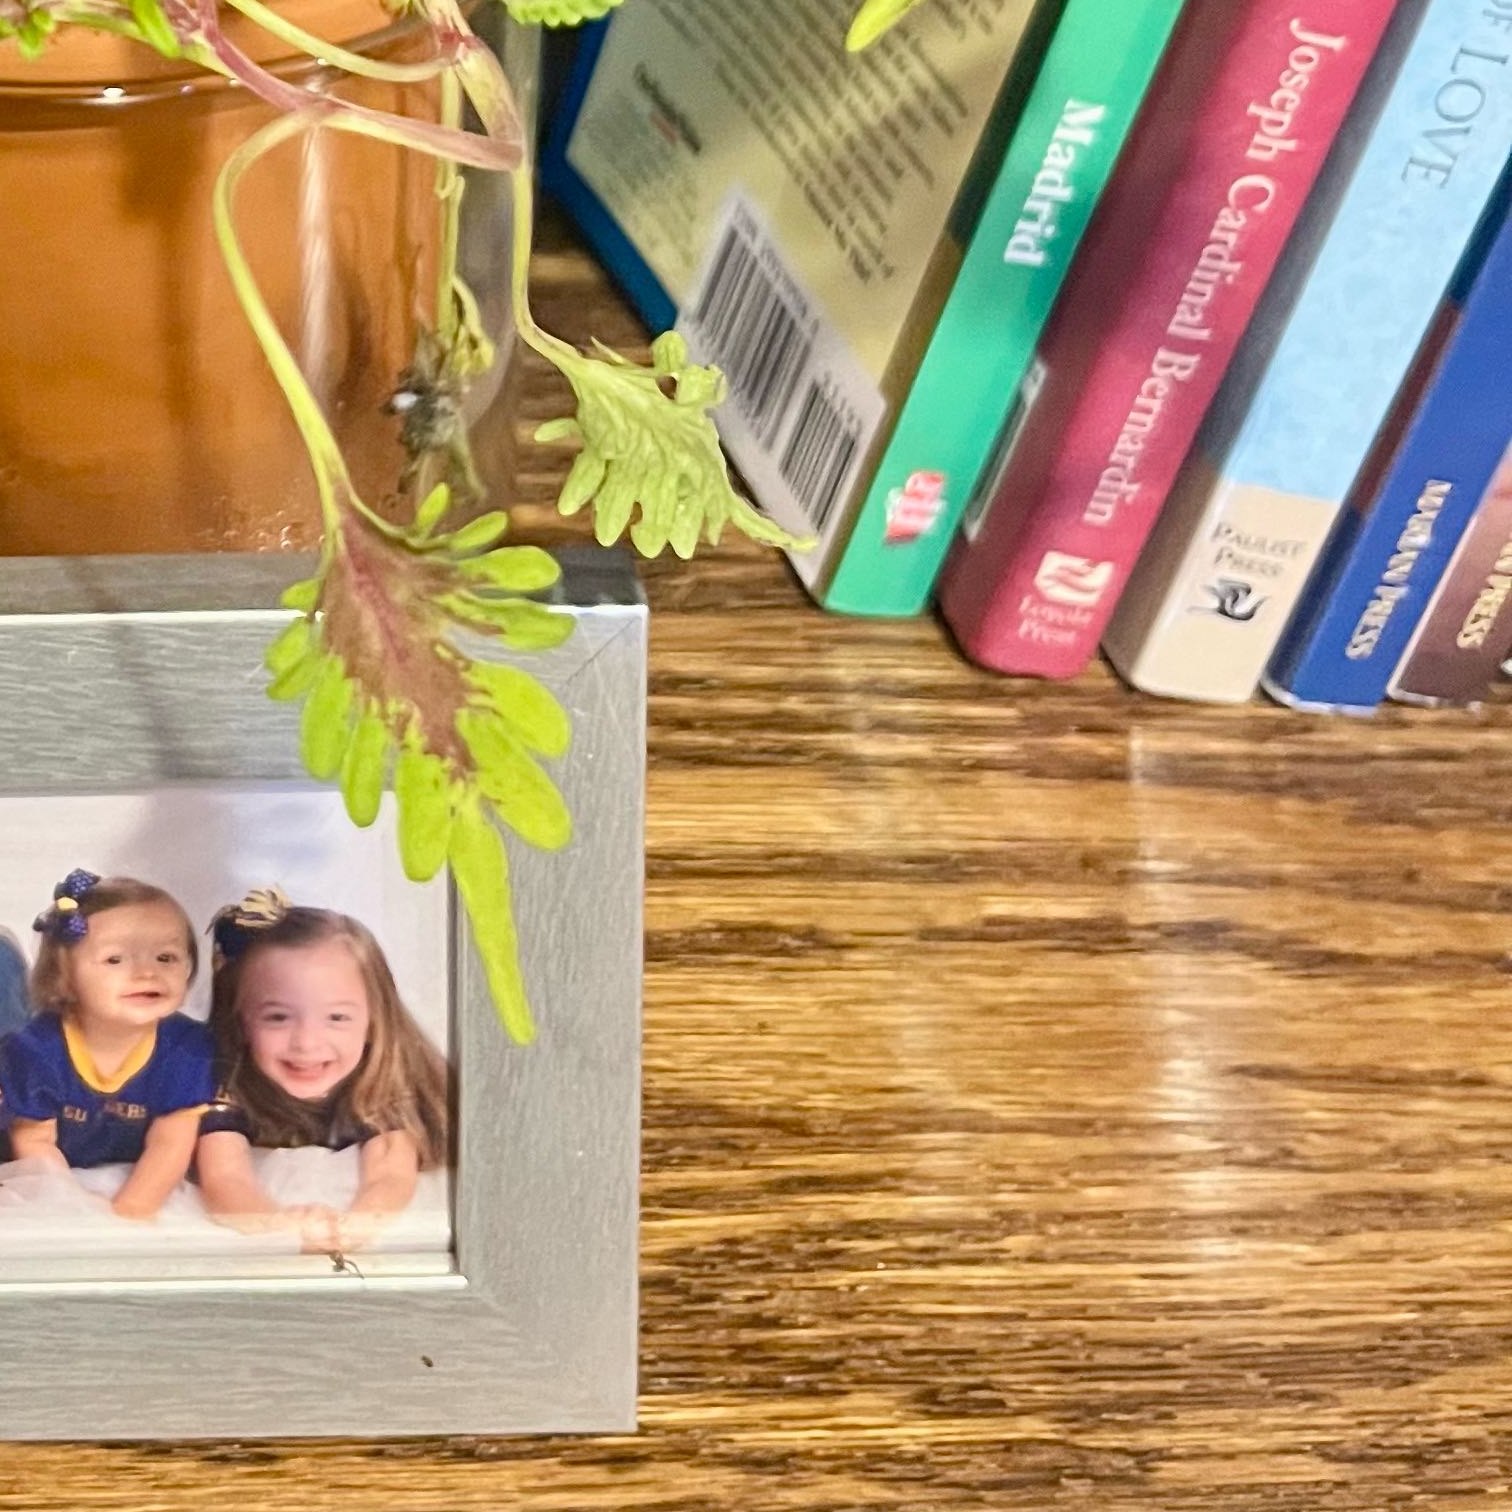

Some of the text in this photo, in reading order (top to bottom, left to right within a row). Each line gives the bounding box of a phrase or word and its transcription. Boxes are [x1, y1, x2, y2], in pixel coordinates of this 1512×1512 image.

[1004, 98, 1107, 268] Madrid
[1401, 45, 1510, 190] LOVE
[1082, 16, 1349, 527] Joseph Cardinal Bernardin
